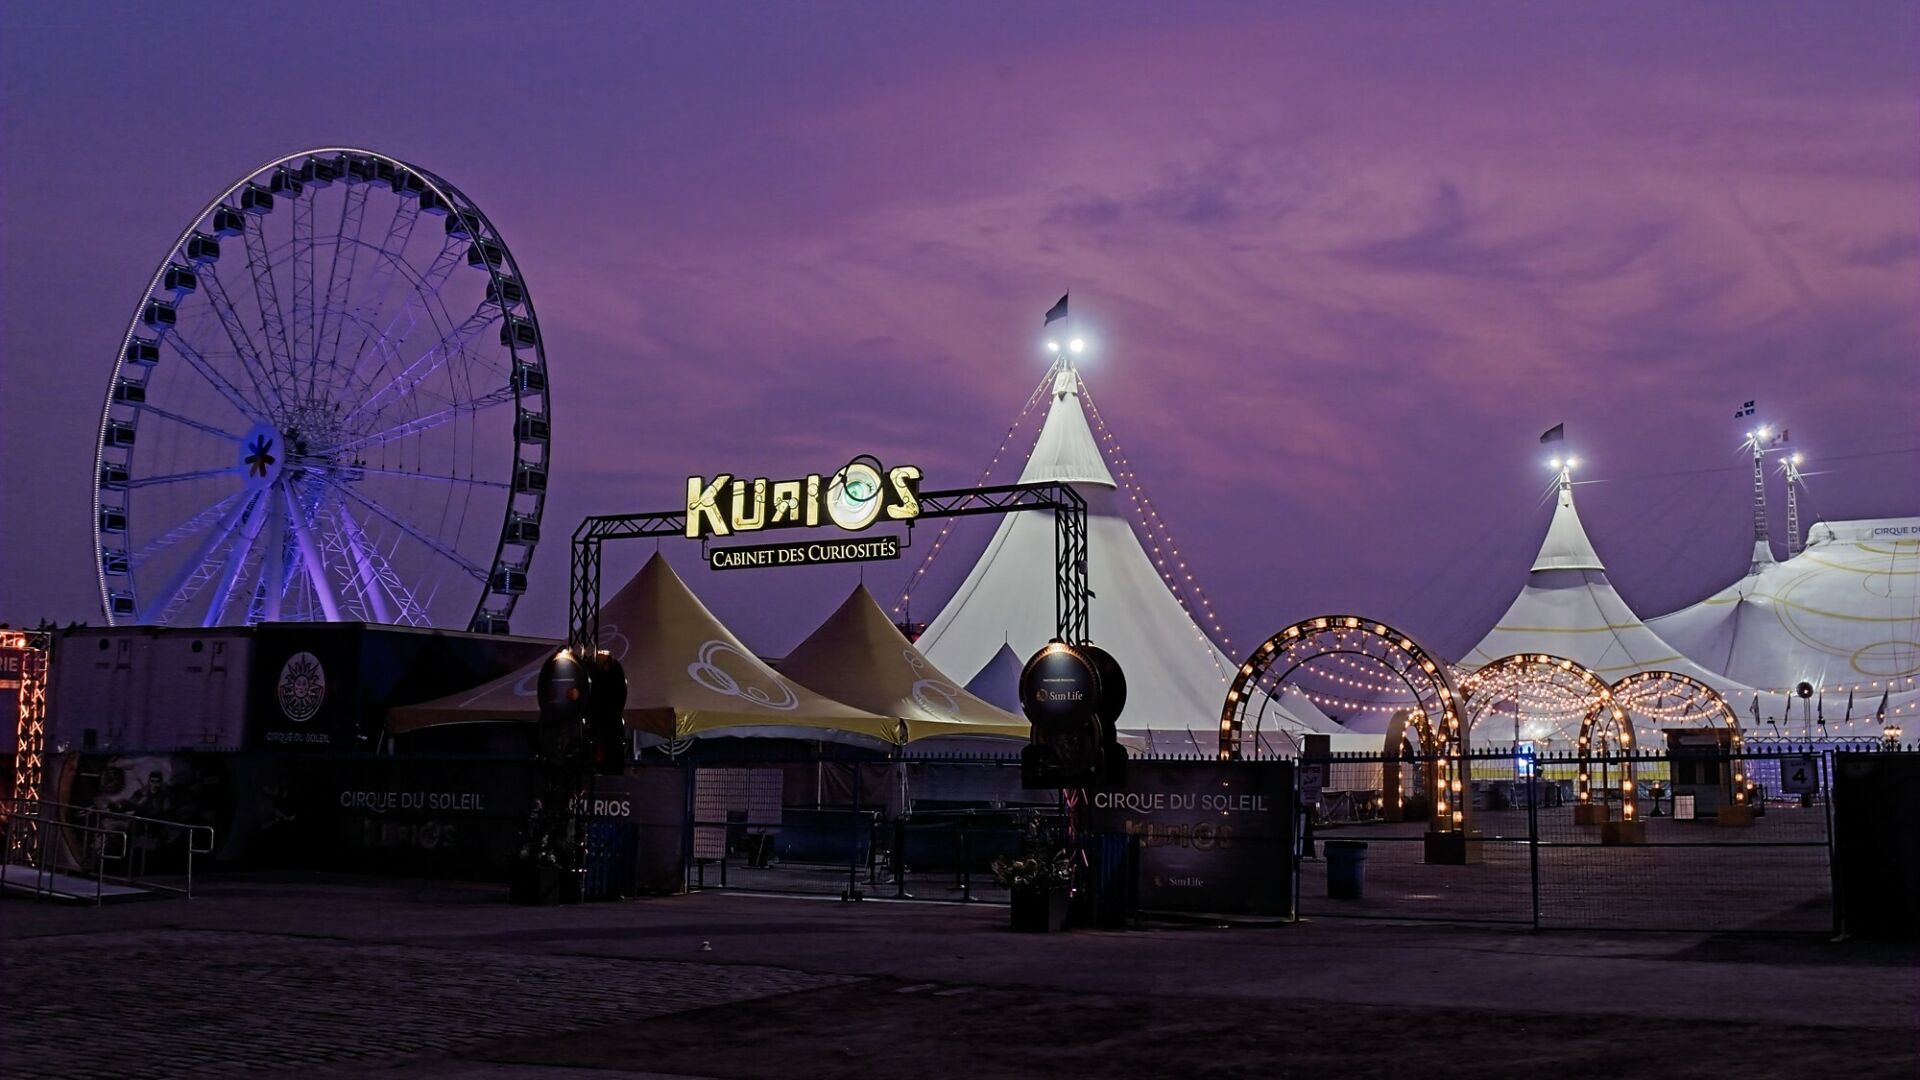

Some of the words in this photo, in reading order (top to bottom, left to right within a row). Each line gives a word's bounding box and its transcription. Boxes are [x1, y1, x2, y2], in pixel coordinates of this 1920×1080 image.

[1874, 526, 1909, 537] CIRQUE
[712, 549, 774, 568] CABINET
[777, 548, 805, 564] DES
[808, 539, 897, 559] CURIOSITÉS
[1049, 691, 1066, 701] Sun
[1067, 690, 1083, 701] Life
[1792, 768, 1808, 784] 4
[340, 790, 398, 813] CIRQUE
[401, 791, 425, 809] DU
[429, 792, 485, 811] SOLEIL
[1094, 792, 1164, 814] CIRQUE
[1170, 793, 1195, 810] DU
[1201, 794, 1269, 812] SOLEIL
[1168, 876, 1186, 887] Sun
[1187, 876, 1204, 887] Life
